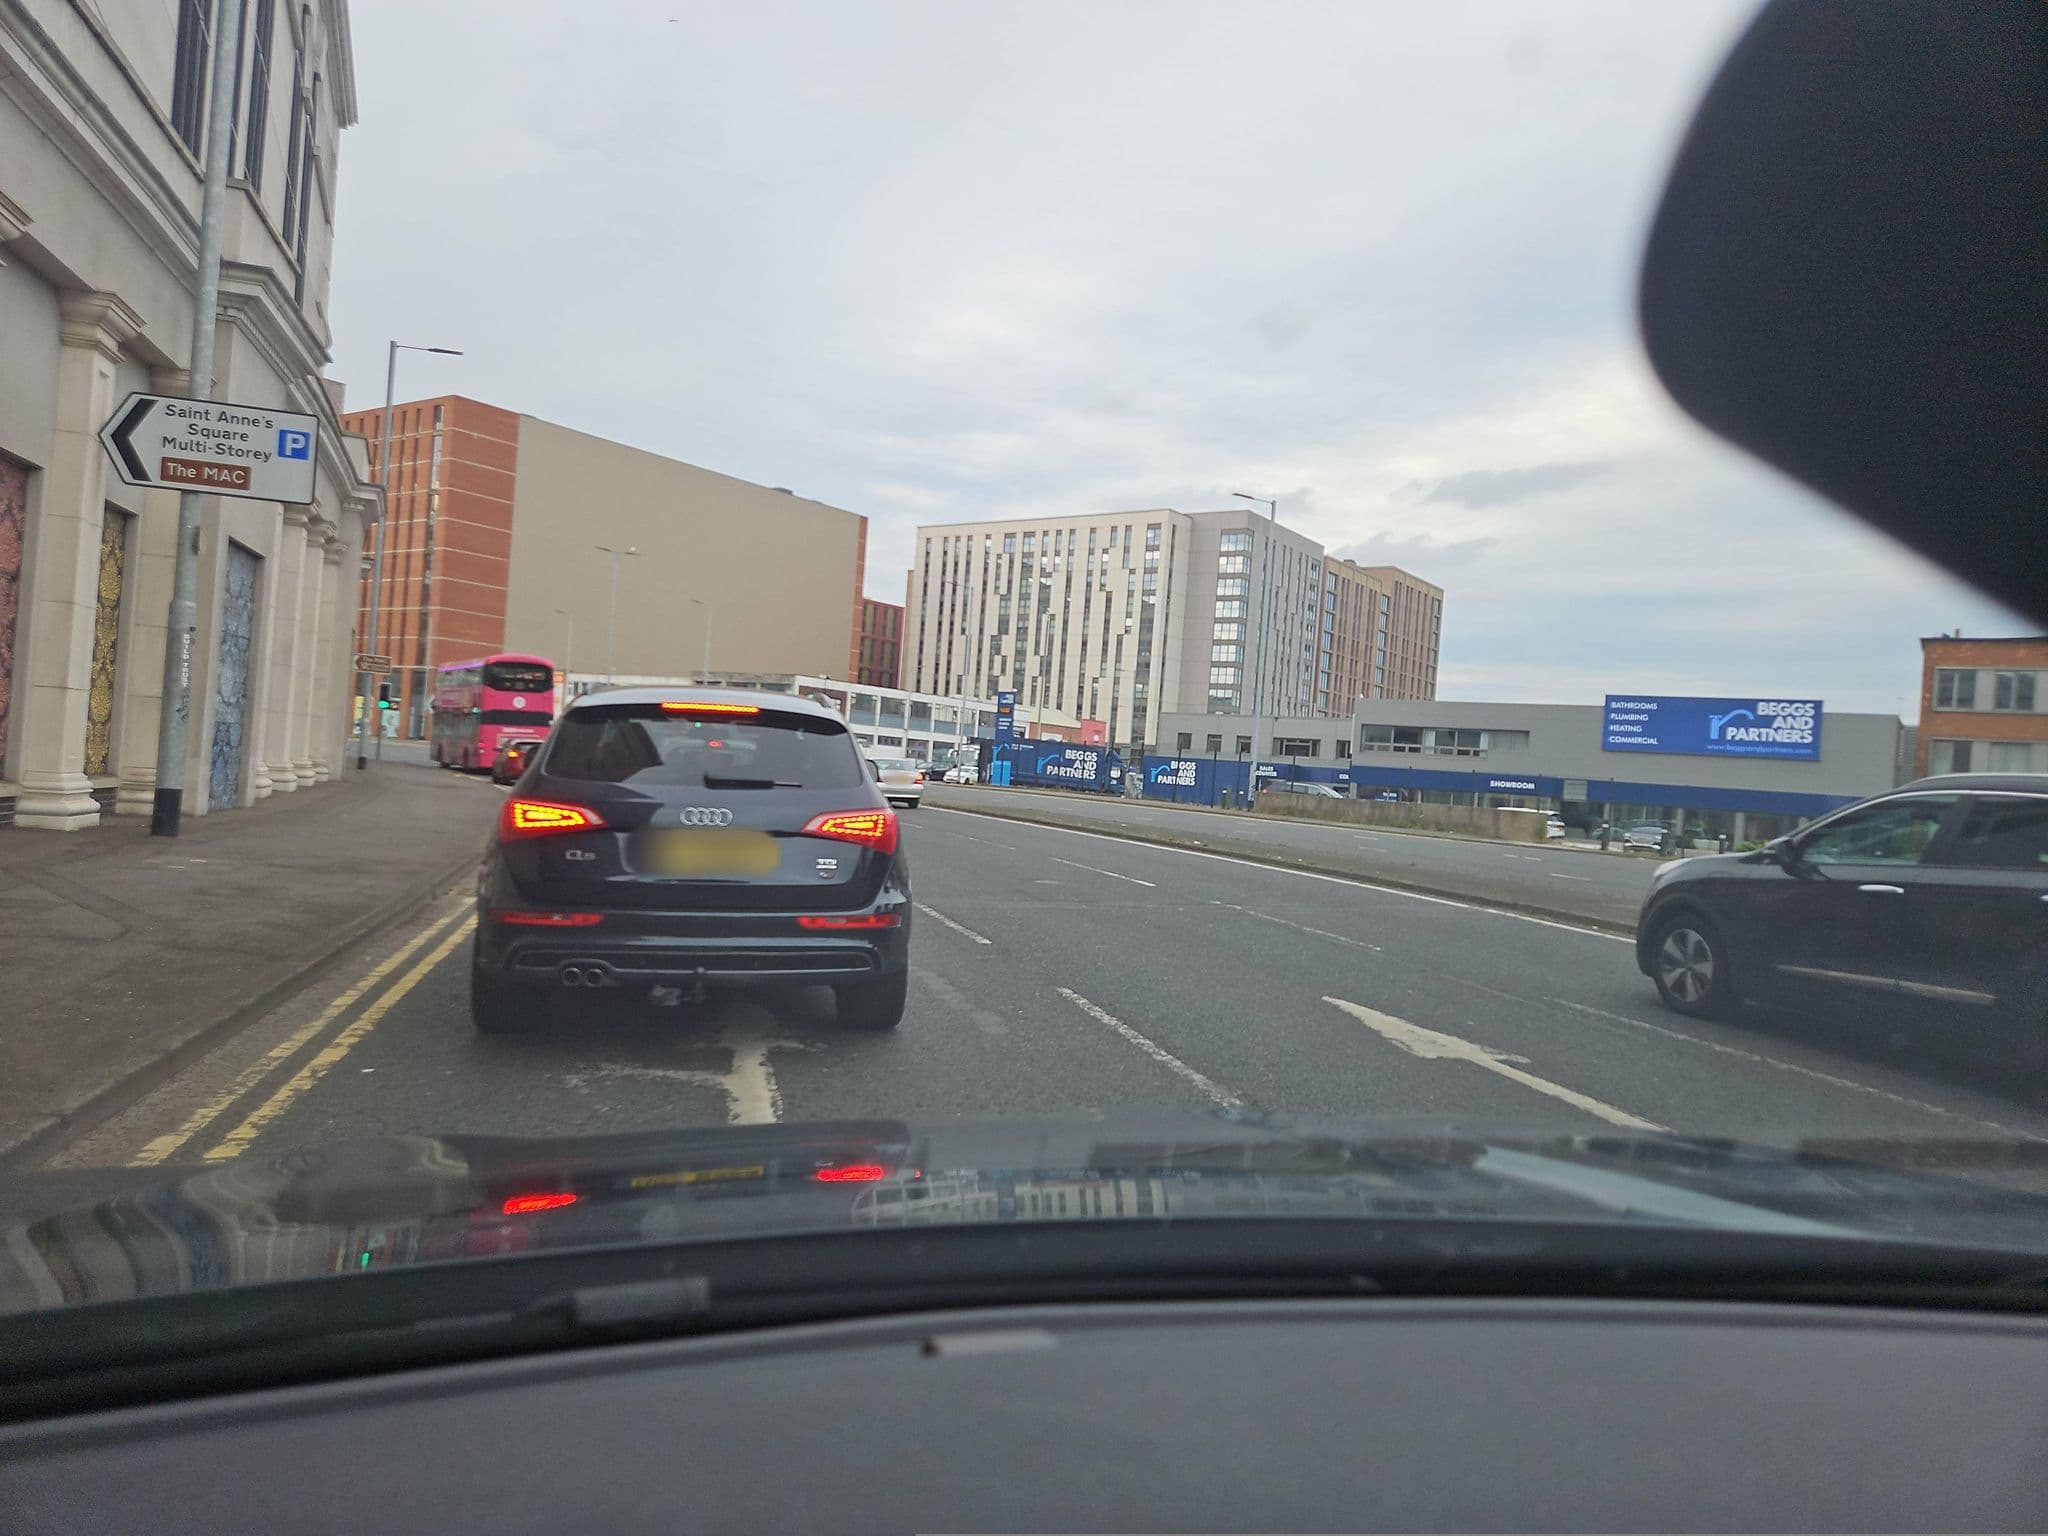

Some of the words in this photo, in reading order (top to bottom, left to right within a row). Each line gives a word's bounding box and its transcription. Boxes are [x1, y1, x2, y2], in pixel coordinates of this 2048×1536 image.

[165, 404, 211, 421] Saint
[217, 411, 274, 429] Anne's
[187, 423, 249, 442] Square
[162, 436, 272, 463] Multi-Storey
[285, 433, 306, 456] P
[167, 462, 197, 478] The
[204, 466, 245, 484] MAC
[1611, 701, 1658, 710] BATHROOMS
[1757, 702, 1815, 716] BEGGS
[1610, 713, 1649, 721] PLUMBING
[1772, 716, 1814, 730] AND
[1610, 724, 1643, 732] HEATING
[1609, 735, 1659, 745] COMMERCIAL
[1726, 727, 1813, 743] PARTNERS
[1065, 749, 1098, 762] BEGGS
[1073, 760, 1097, 771] AND
[1046, 765, 1096, 780] PARTNERS
[1177, 769, 1196, 778] AND
[1157, 774, 1196, 786] PARTNERS
[1490, 780, 1535, 790] SHOWROOM
